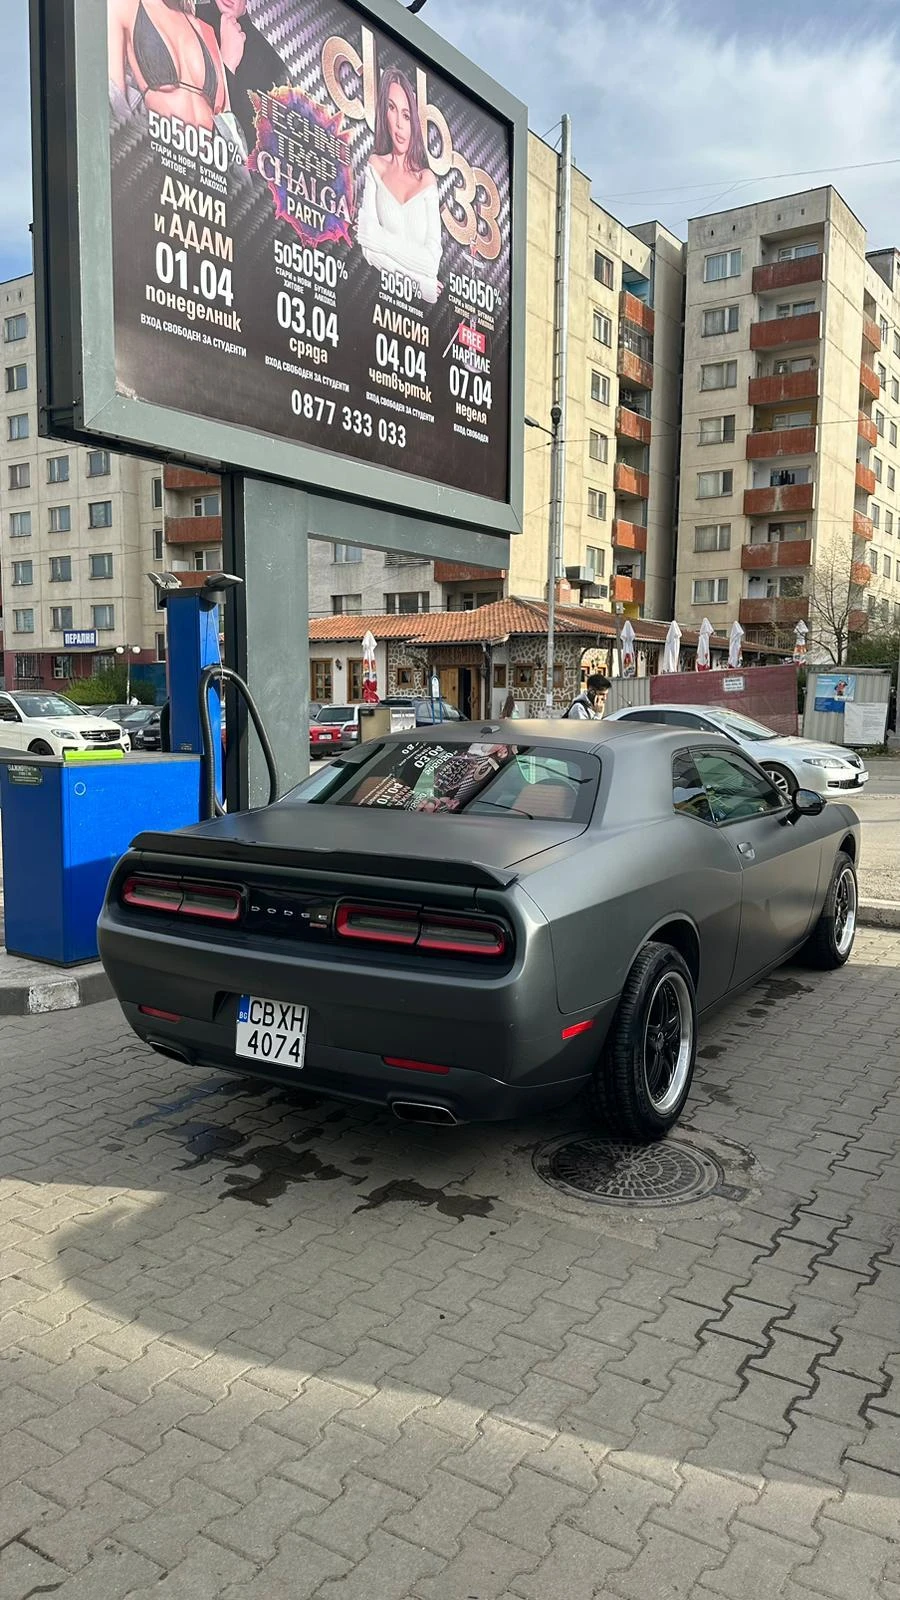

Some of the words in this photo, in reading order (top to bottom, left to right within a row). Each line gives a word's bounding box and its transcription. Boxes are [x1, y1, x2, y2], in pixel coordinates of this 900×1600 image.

[257, 89, 351, 166] TECHNO
[150, 141, 172, 159] СТАРИ
[178, 153, 196, 170] НОВИ
[160, 157, 187, 176] ХИТОВЕ
[273, 129, 337, 181] TRAD
[200, 166, 228, 186] БУТИЛКА
[200, 175, 228, 194] АЛКОХОЛ
[256, 150, 353, 224] CHALGA
[160, 175, 227, 227] ДЖИЯ
[286, 196, 326, 232] PARTY
[168, 214, 234, 263] АДАМ
[155, 241, 234, 307] 01.04
[275, 266, 293, 281] СТАРИ
[145, 284, 242, 333] понеделник
[277, 291, 339, 348] 03.04
[372, 303, 430, 348] АЛИСИЯ
[140, 313, 162, 332] ВХОД
[162, 321, 202, 343] СВОБОДЕН
[202, 332, 213, 345] ЗА
[212, 337, 247, 358] СТУДЕНТИ
[289, 337, 328, 365] сряда
[461, 328, 482, 349] FREE
[264, 355, 282, 371] ВХОД
[282, 360, 314, 380] СВОБОДЕН
[314, 372, 322, 384] ЗА
[322, 376, 350, 393] СТУДЕНТИ
[376, 332, 427, 384] 04.04
[452, 343, 491, 375] НАРГИЛЕ
[368, 367, 432, 404] четвъртък
[450, 365, 493, 410] 07.04
[291, 389, 336, 426] 0877
[342, 406, 373, 438] 333
[378, 418, 407, 449] 033
[366, 391, 380, 405] ВХОД
[380, 395, 406, 412] СВОБОДЕН
[405, 404, 412, 414] ЗА
[412, 407, 435, 424] СТУДЕНТИ
[455, 401, 488, 425] неделя
[453, 423, 466, 436] ВХОД
[466, 426, 489, 444] СВОБОДЕН
[64, 633, 95, 644] ПЕРАЛНЯ
[251, 905, 328, 920] DODGE
[239, 1011, 248, 1020] BG
[248, 1029, 301, 1063] 4074
